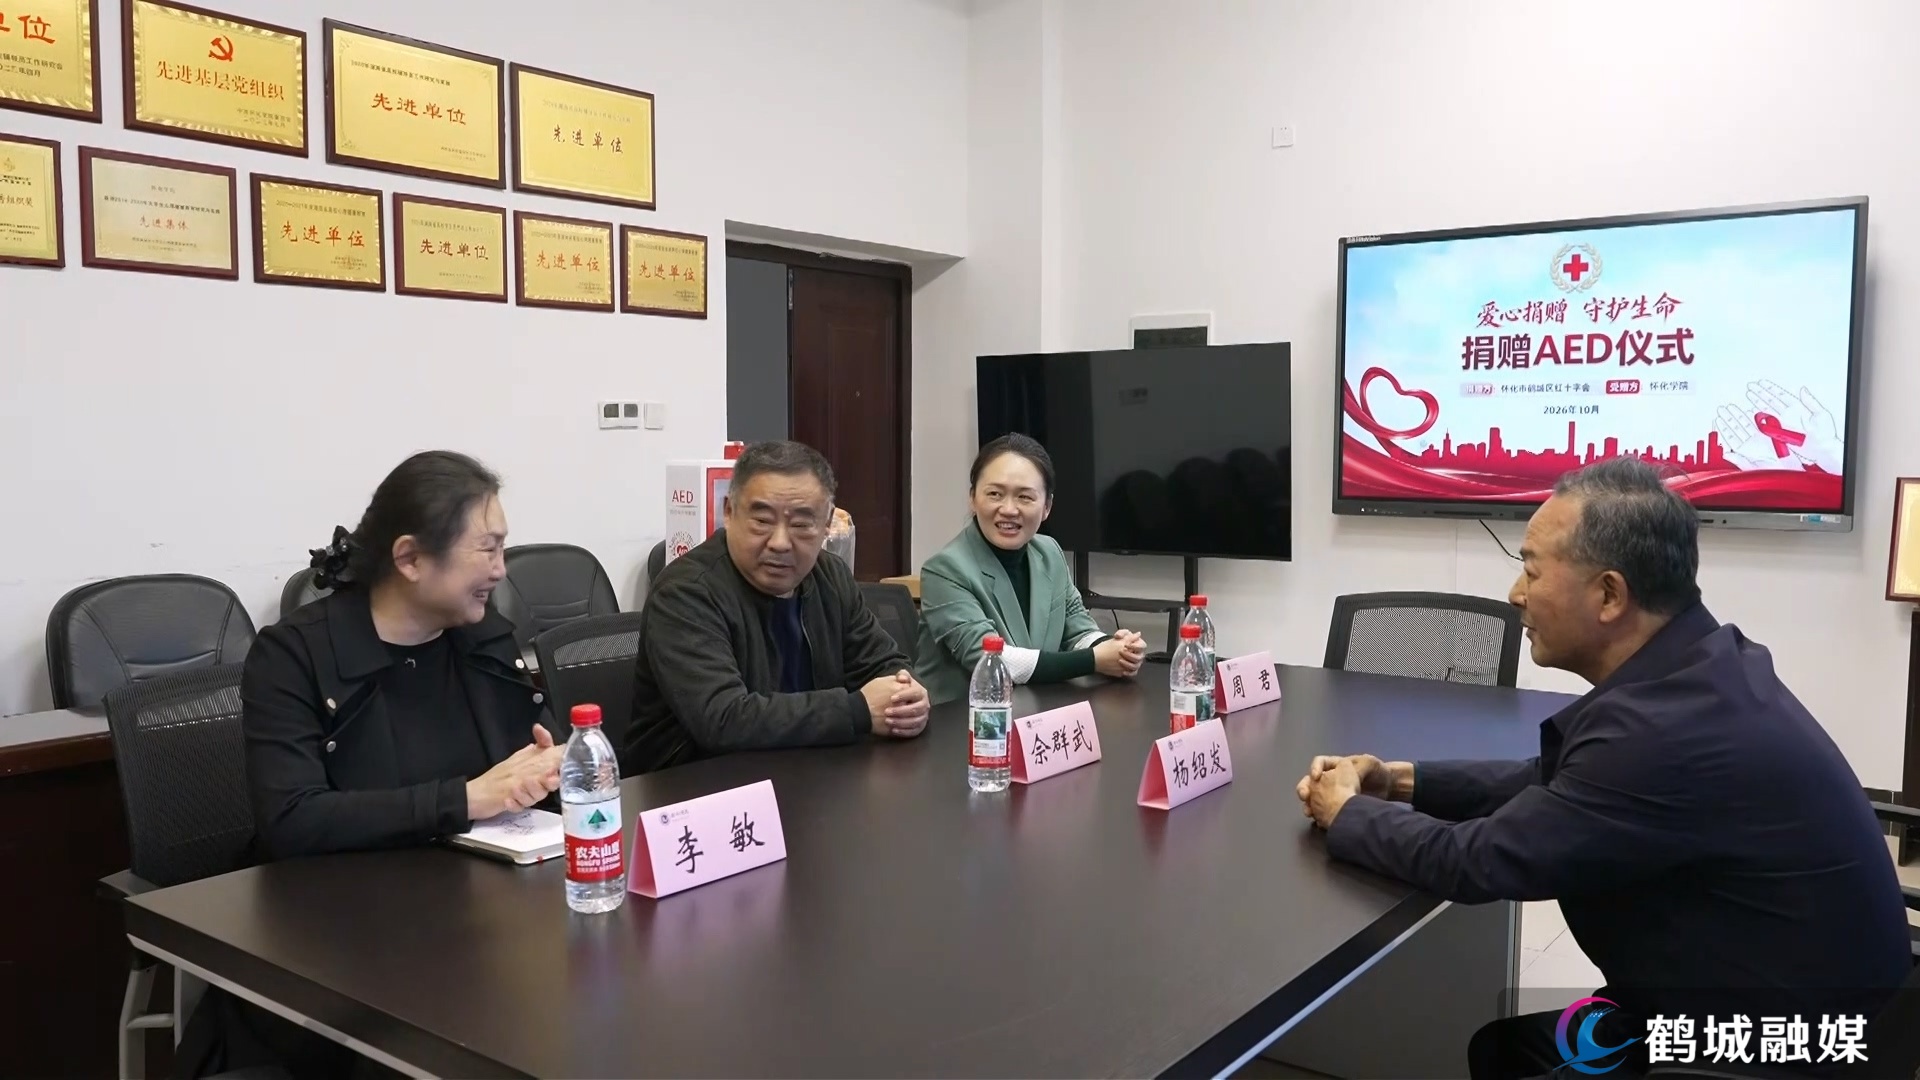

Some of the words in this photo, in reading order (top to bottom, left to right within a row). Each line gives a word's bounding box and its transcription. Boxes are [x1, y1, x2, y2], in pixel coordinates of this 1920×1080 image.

[0, 12, 56, 44] 位
[156, 60, 285, 101] 先进基层党组织
[371, 92, 467, 125] 先进单位
[553, 124, 624, 154] 先进单位
[139, 214, 189, 231] 先进集体
[280, 220, 366, 248] 先进单位
[419, 238, 489, 260] 先进单位
[535, 250, 601, 272] 先进单位
[638, 260, 696, 282] 先进单位
[1476, 298, 1569, 328] 爱心捐赠
[1583, 292, 1683, 325] 守护生命
[1461, 327, 1695, 371] 捐赠AED仪式
[1649, 381, 1689, 392] 怀化学院
[1543, 404, 1600, 415] 2026年10月
[671, 489, 694, 504] AED
[1172, 742, 1227, 788] 杨绍发
[675, 811, 766, 874] 李敏
